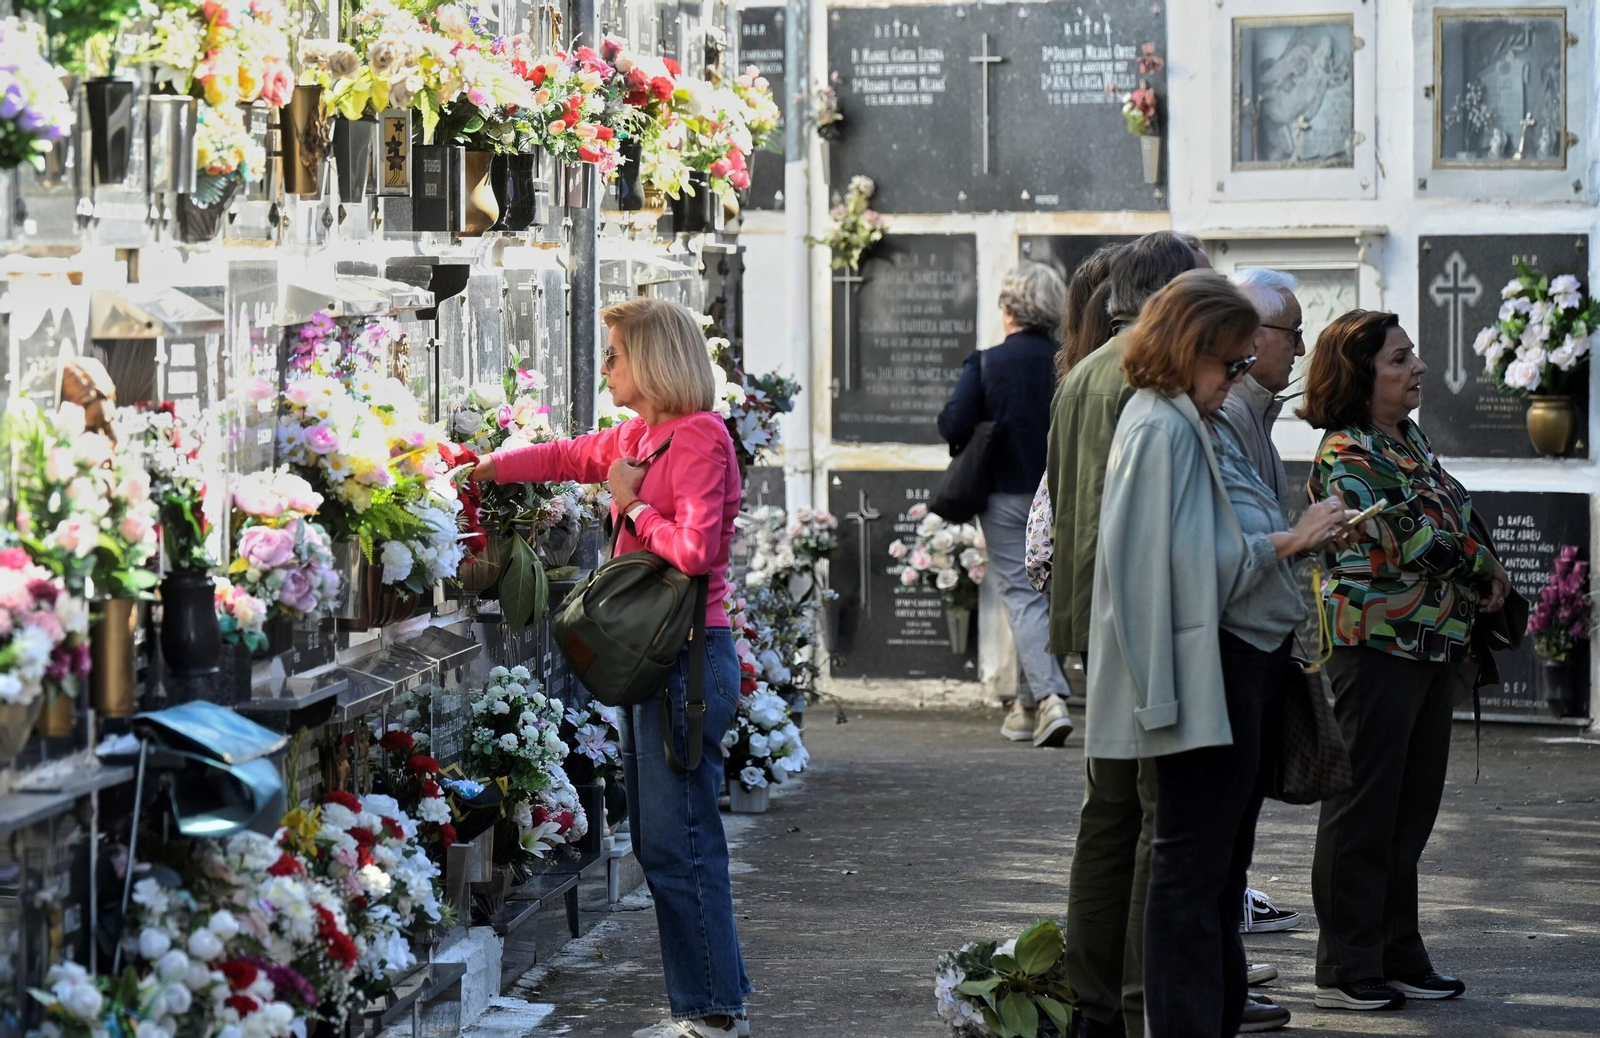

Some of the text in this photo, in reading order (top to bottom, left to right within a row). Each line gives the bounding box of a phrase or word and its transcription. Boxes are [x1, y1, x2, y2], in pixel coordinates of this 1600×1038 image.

[1507, 515, 1536, 528] RAFAEL
[1517, 530, 1541, 541] ABREU
[1516, 543, 1528, 553] LOS
[1537, 541, 1555, 554] AÑOS
[1504, 557, 1541, 570] ANTONIA
